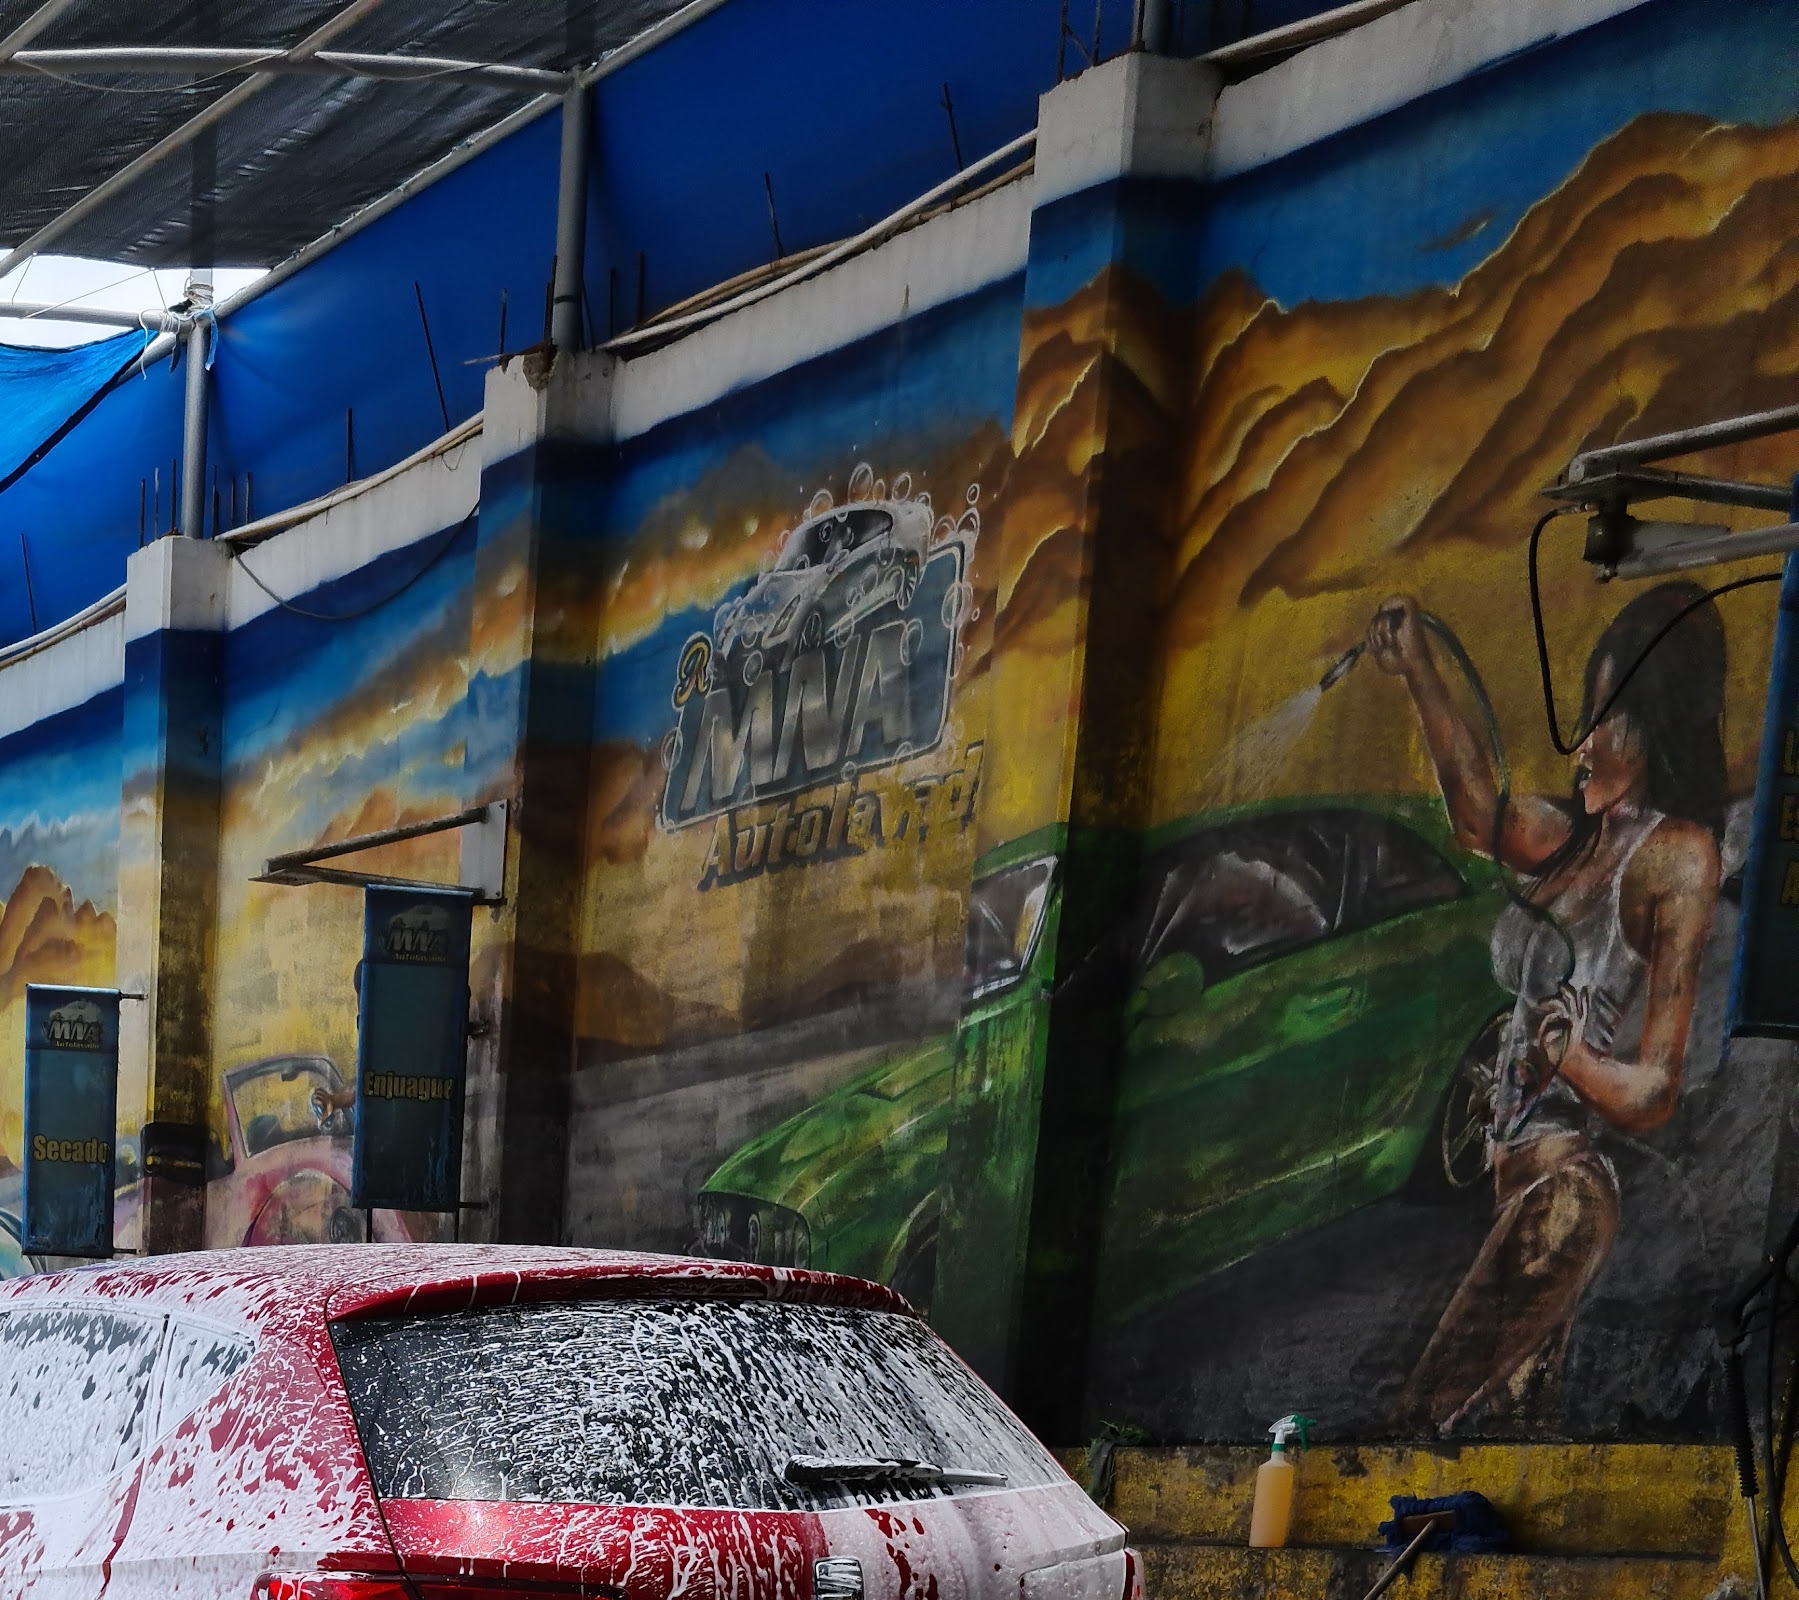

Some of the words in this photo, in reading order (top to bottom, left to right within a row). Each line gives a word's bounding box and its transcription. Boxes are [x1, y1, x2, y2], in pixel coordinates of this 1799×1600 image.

[680, 622, 912, 811] MNA
[387, 926, 448, 952] MNA
[48, 1020, 101, 1041] MNA
[363, 1070, 454, 1101] Enjuague
[33, 1134, 109, 1164] Secado
